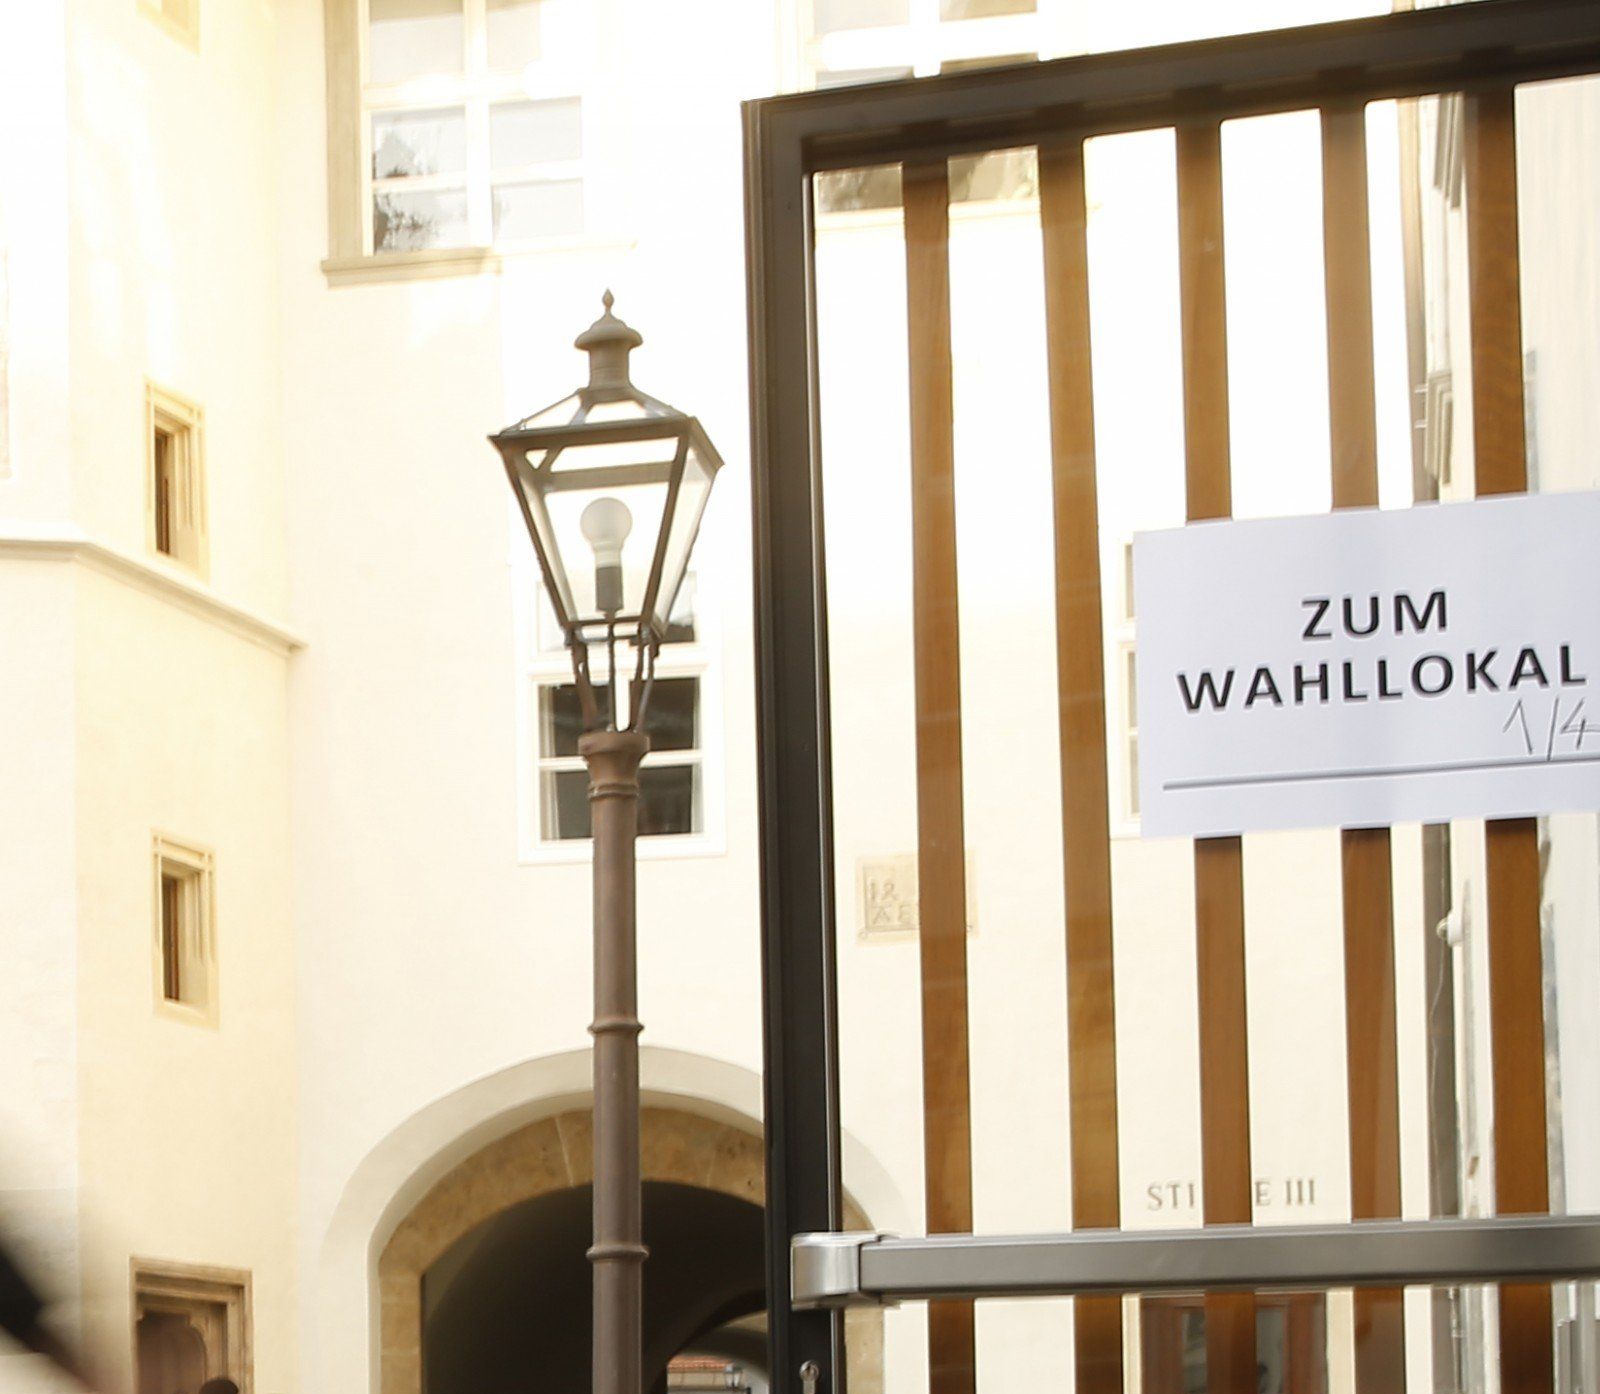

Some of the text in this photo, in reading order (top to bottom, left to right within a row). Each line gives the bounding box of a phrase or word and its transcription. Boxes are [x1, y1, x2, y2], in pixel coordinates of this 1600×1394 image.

[1302, 590, 1448, 640] ZUM
[1176, 644, 1587, 713] WAHLLOKAL
[1146, 1178, 1316, 1212] STIE III
